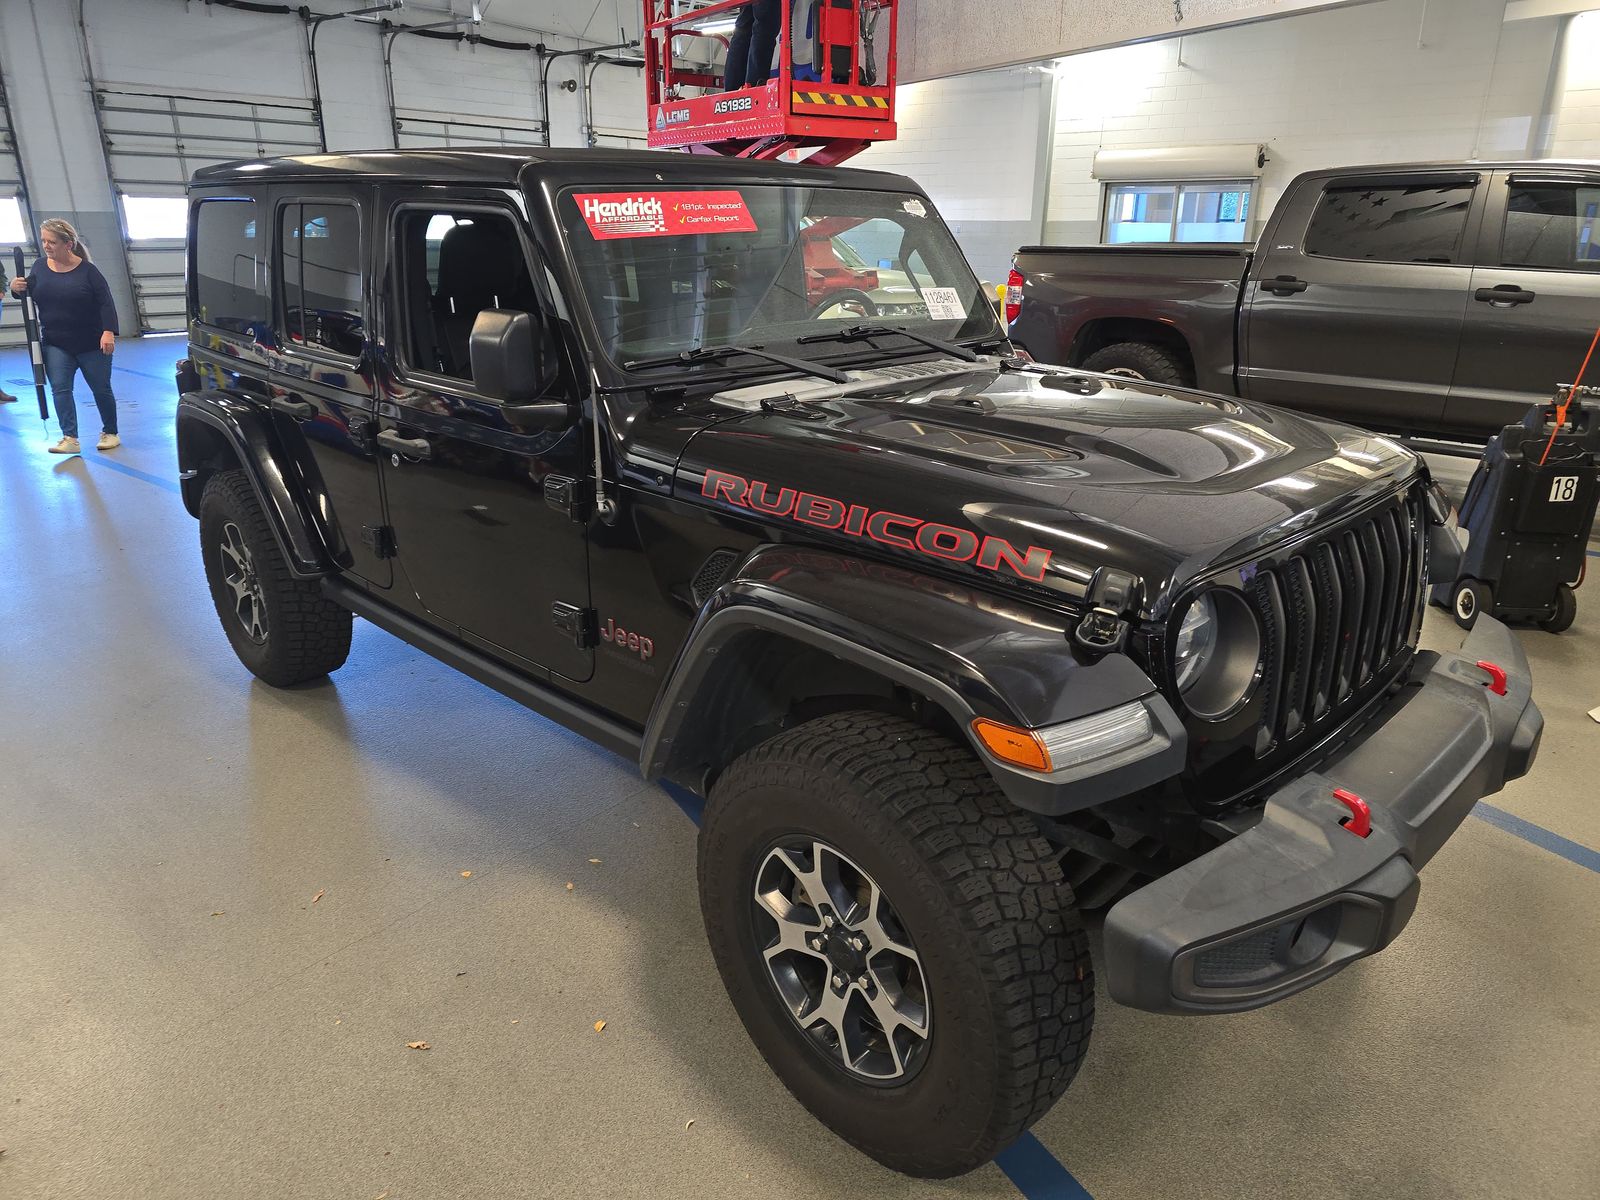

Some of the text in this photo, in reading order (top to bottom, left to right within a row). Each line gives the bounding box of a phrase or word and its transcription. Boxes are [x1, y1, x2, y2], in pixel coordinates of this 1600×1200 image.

[714, 97, 752, 114] AS1932
[666, 109, 690, 124] LGMG
[584, 197, 663, 223] Hendrick
[707, 202, 742, 211] Inspected
[602, 214, 664, 223] AFFORDABLE
[686, 214, 740, 223] Carfax Report
[1554, 478, 1575, 501] 18
[701, 469, 1052, 582] RUBICON
[600, 618, 654, 661] Jeep
